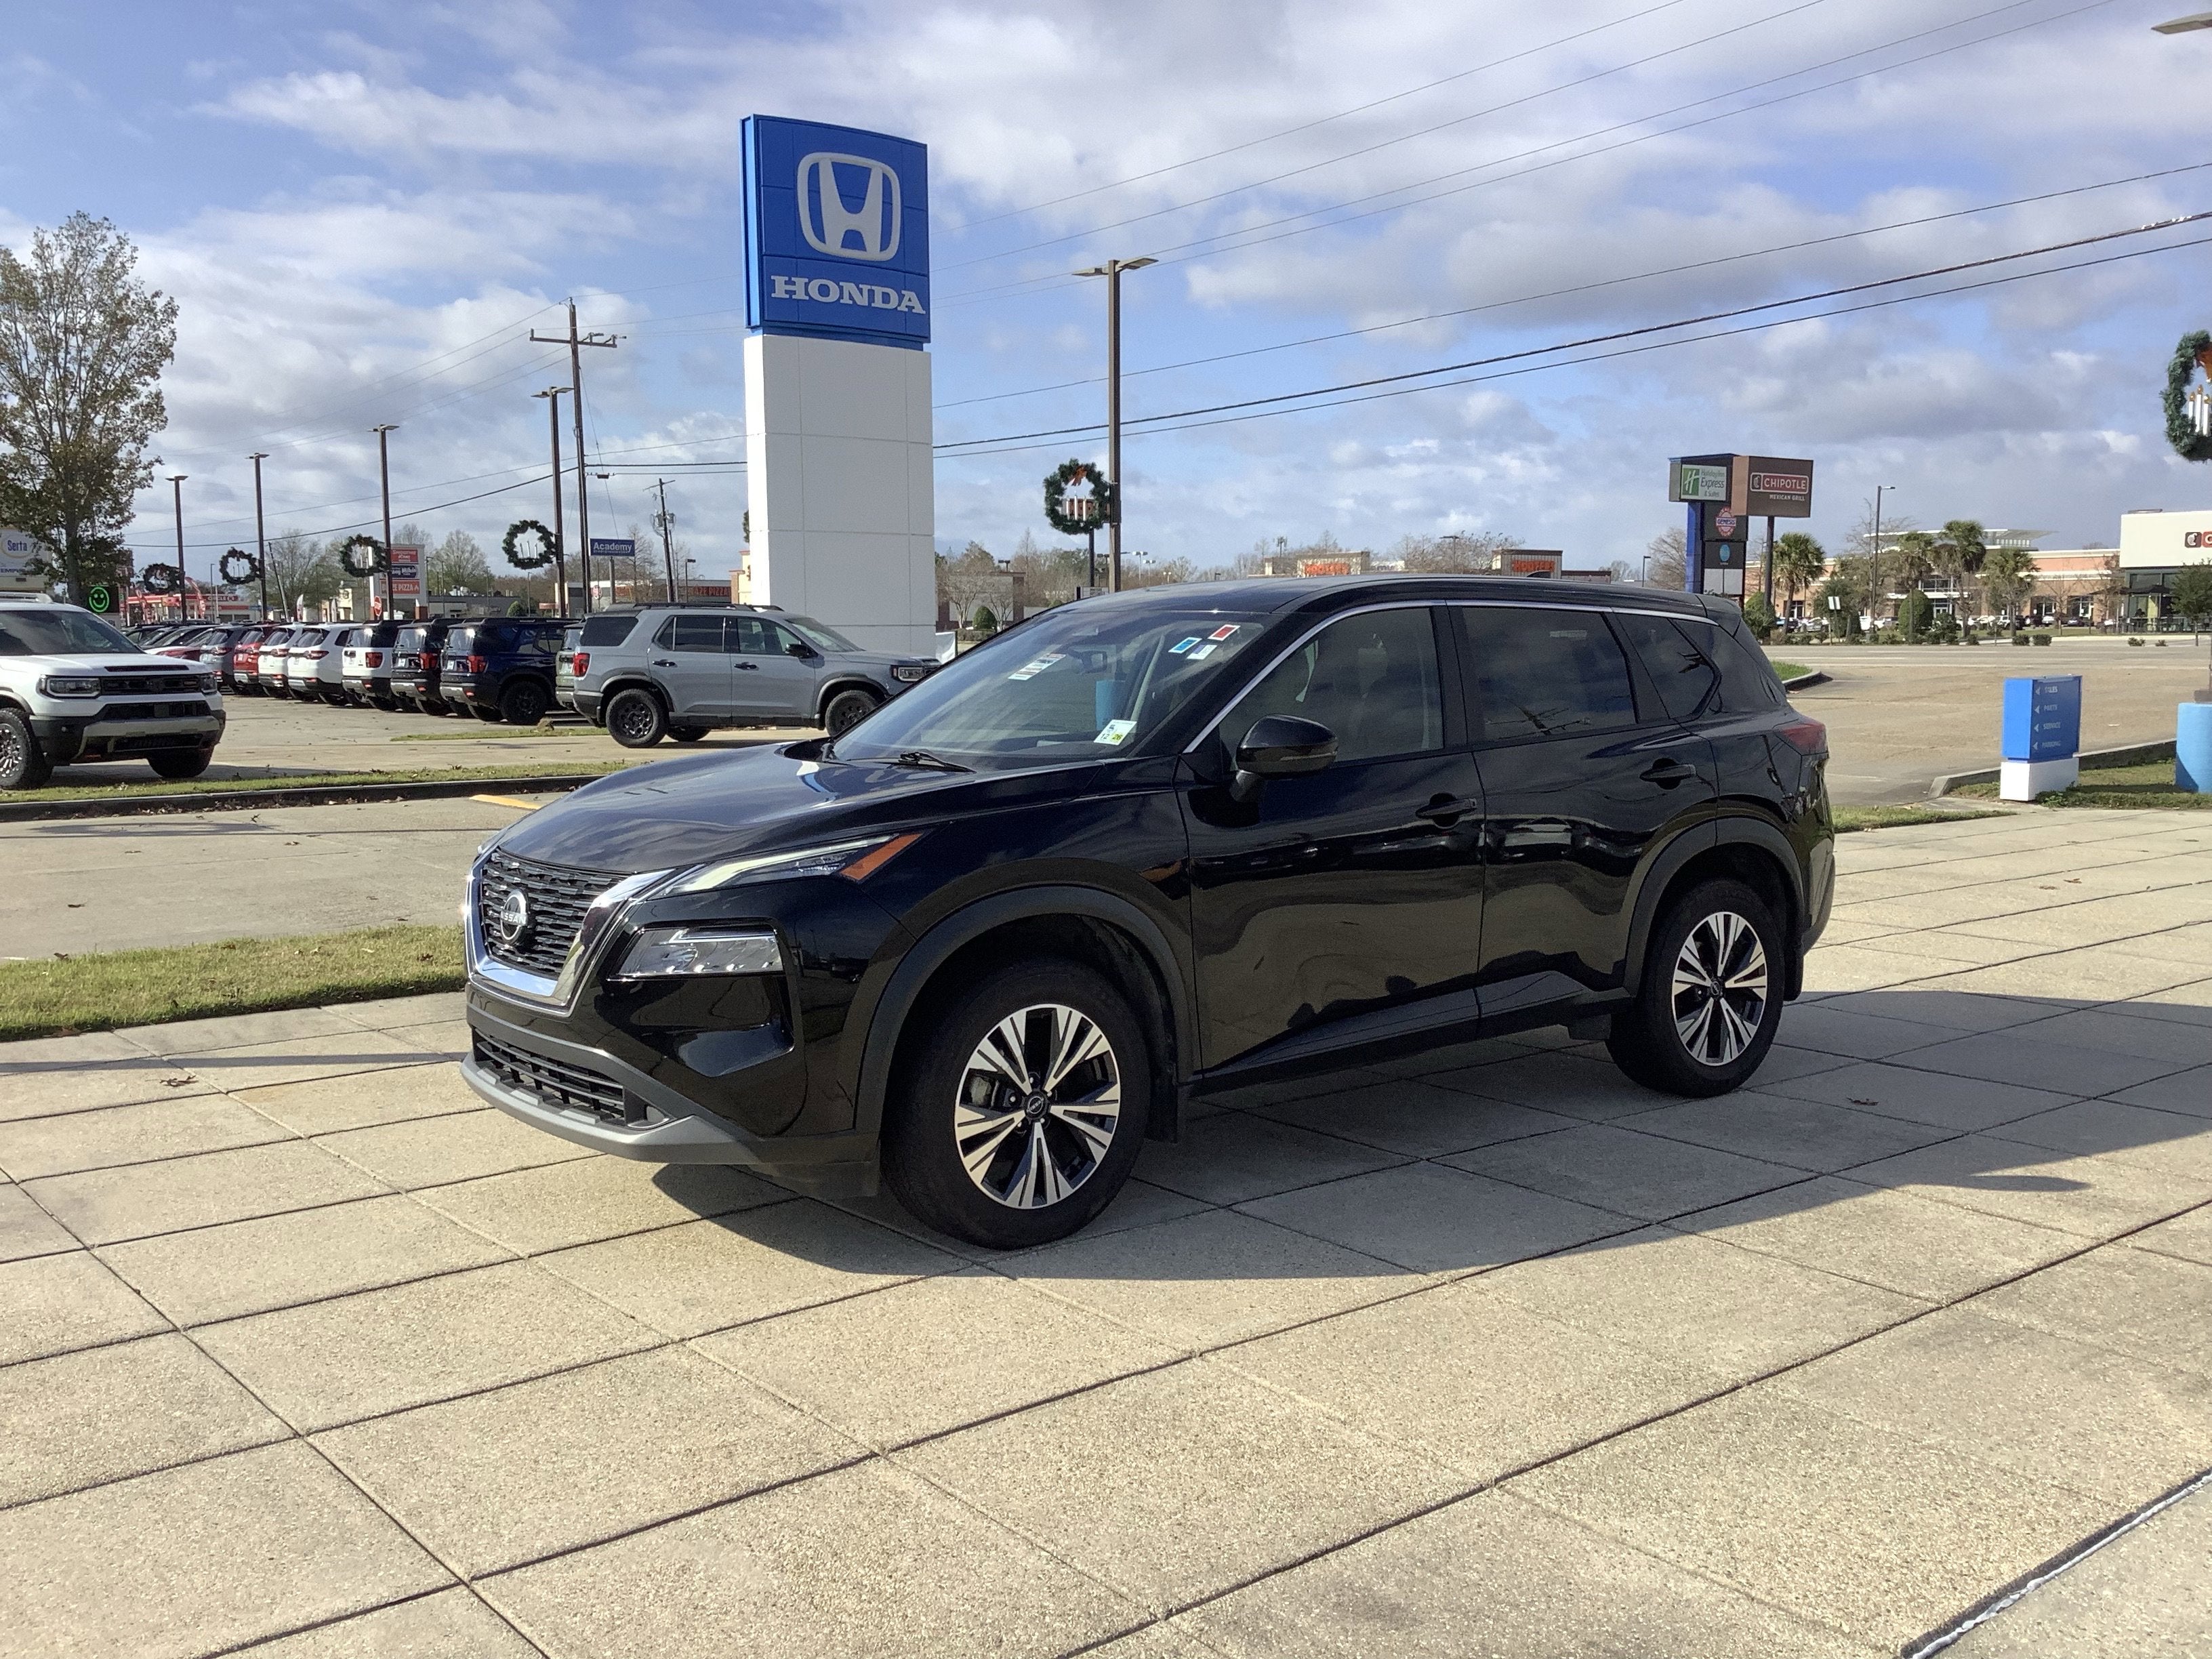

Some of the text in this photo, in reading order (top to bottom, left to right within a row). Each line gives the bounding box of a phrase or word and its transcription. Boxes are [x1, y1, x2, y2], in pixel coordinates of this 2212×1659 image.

[771, 275, 926, 314] HONDA
[1701, 477, 1725, 489] Express
[1764, 478, 1806, 489] CHIPOTLE
[7, 540, 27, 551] Serta
[593, 542, 632, 553] Academy
[398, 583, 414, 592] PIZZA
[501, 912, 527, 924] SSAN
